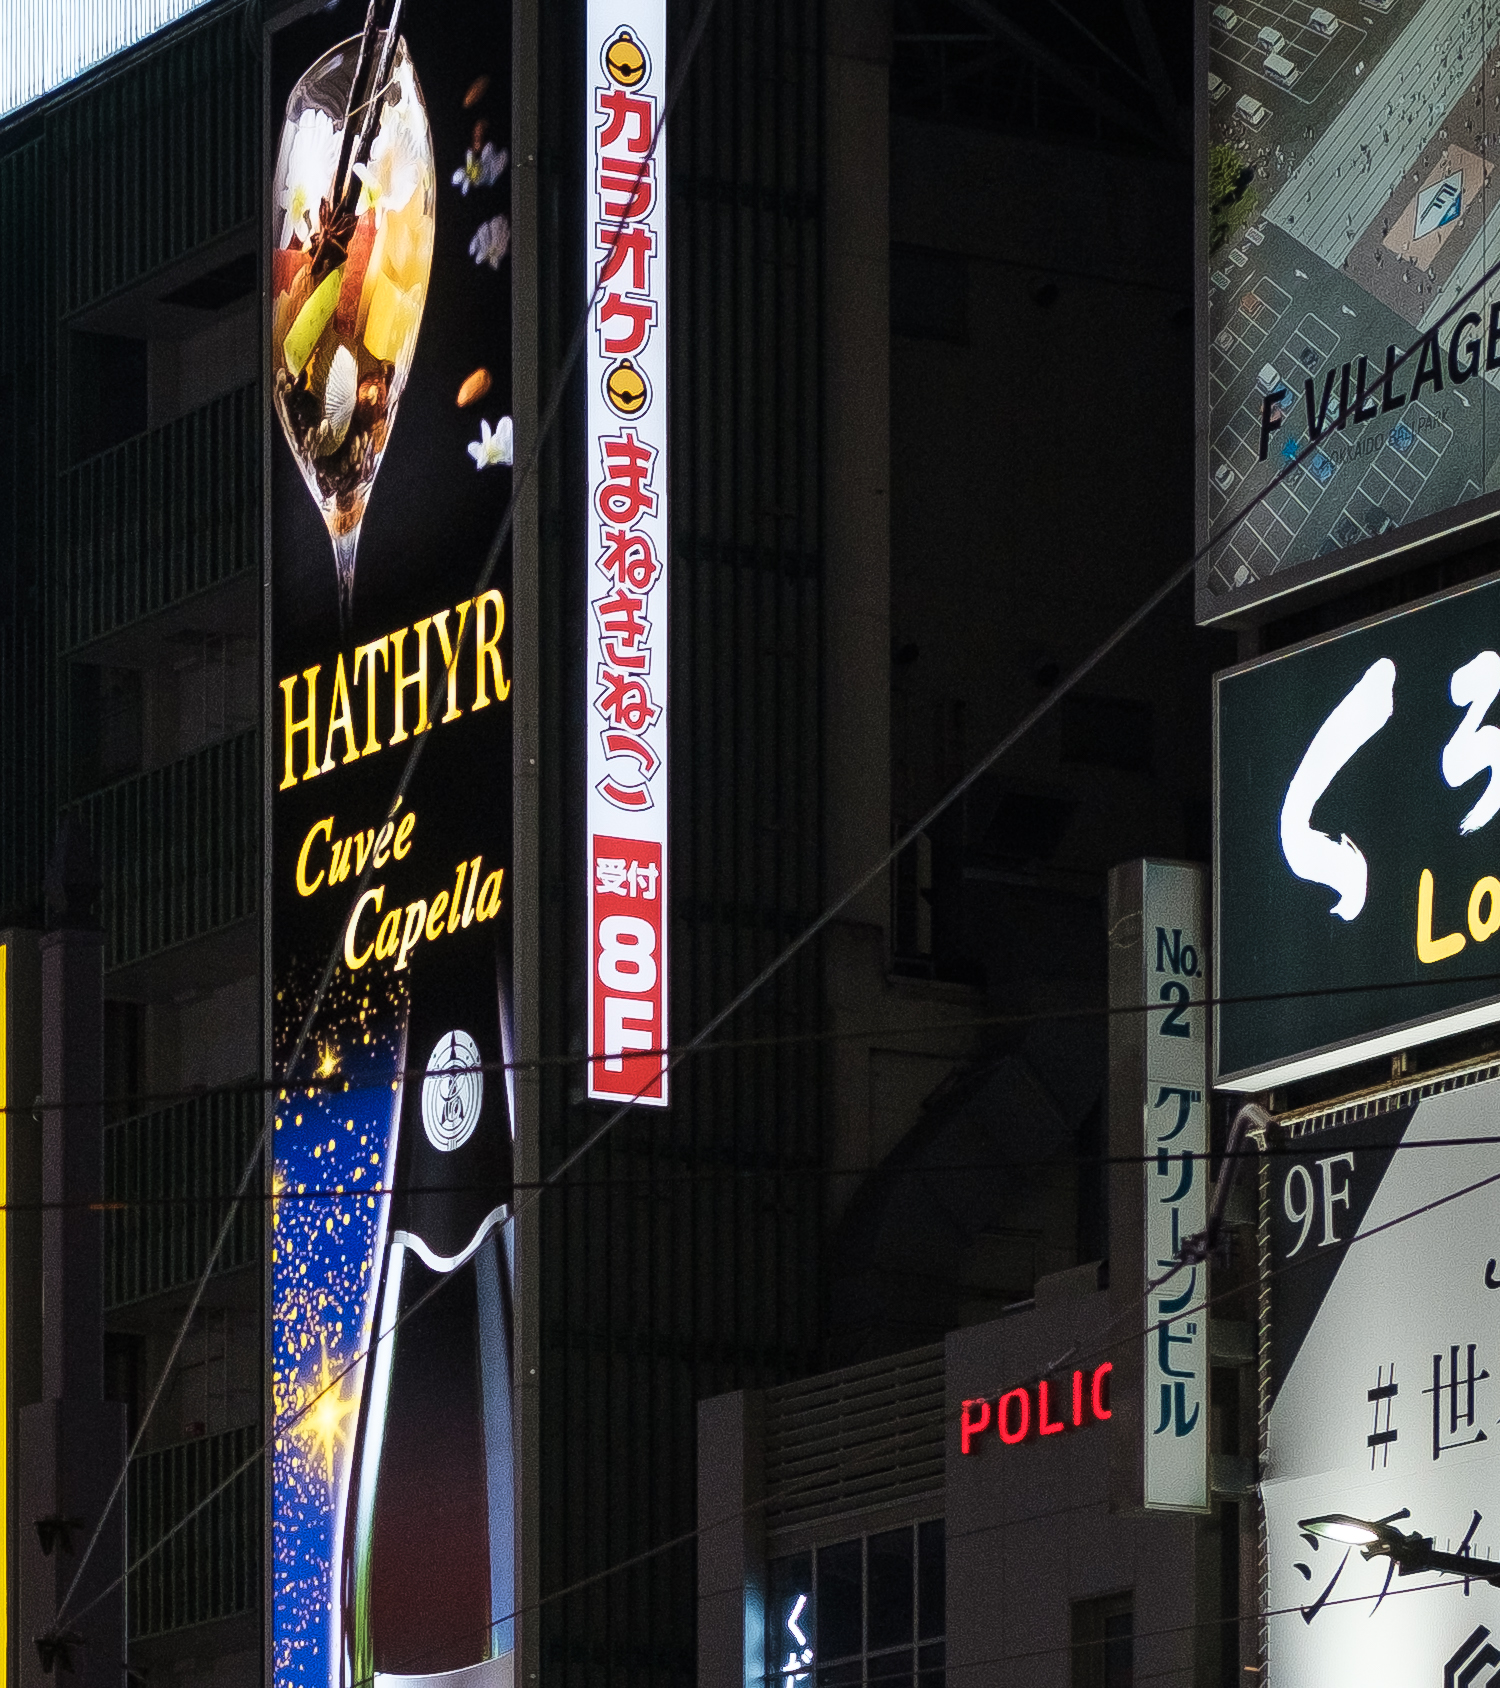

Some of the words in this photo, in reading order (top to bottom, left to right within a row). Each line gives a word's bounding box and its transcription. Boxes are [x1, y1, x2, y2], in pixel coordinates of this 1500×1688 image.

[593, 85, 661, 360] カラオケ
[1259, 389, 1287, 462] F
[278, 588, 511, 791] HATHYR
[591, 426, 663, 814] まねきねこ
[295, 795, 416, 900] Cuvée
[342, 862, 507, 972] Capella
[595, 855, 660, 901] 受付
[595, 911, 663, 1096] 8F
[1152, 1085, 1202, 1439] グリーンビル
[1283, 1153, 1356, 1258] 9F
